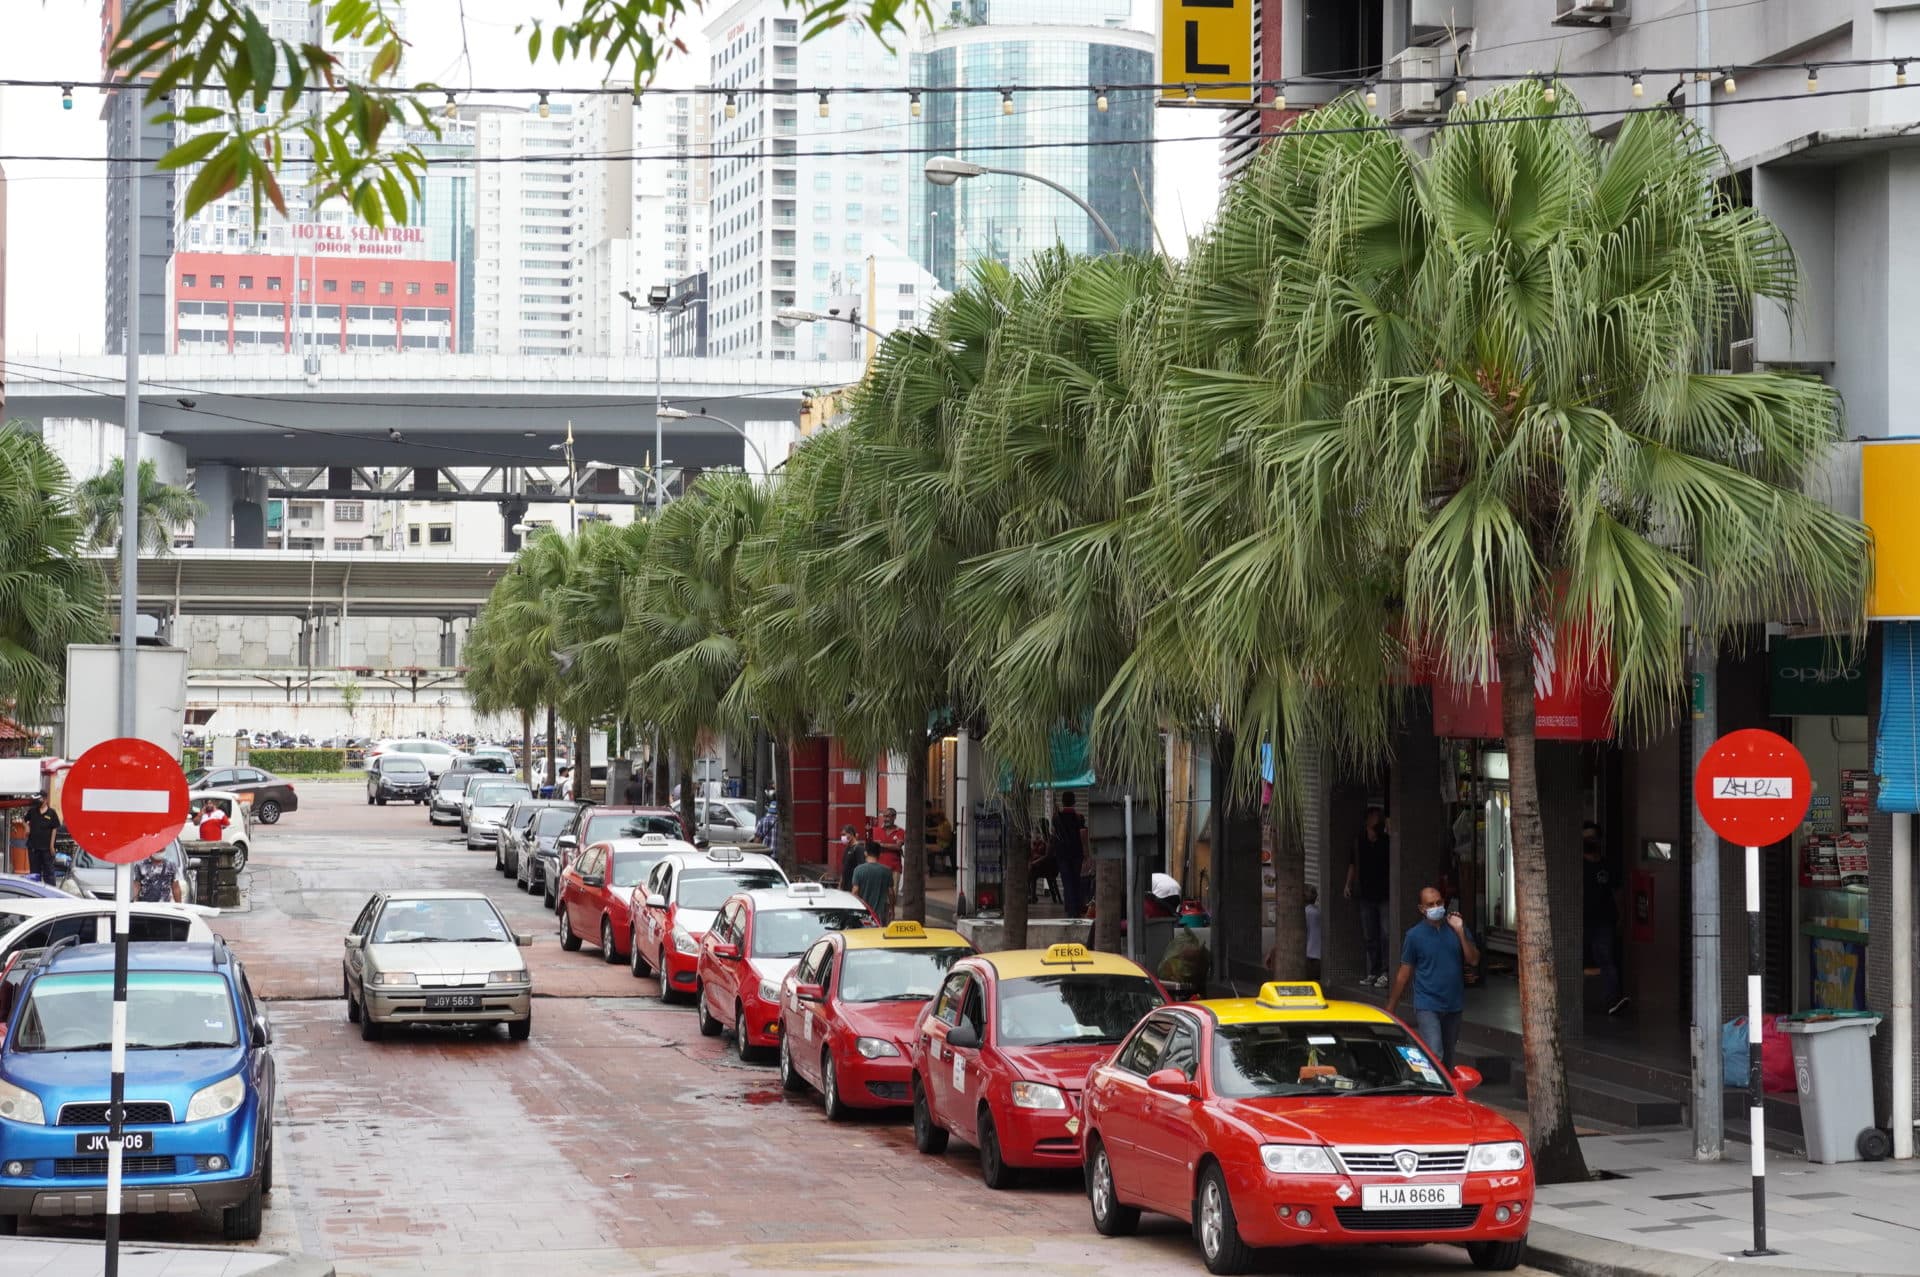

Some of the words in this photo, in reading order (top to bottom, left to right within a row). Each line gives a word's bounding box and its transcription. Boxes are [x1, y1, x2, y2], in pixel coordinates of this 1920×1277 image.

[291, 223, 345, 240] HOTEL
[351, 226, 425, 242] SENTRAL
[314, 242, 352, 253] JOHOR
[359, 244, 402, 254] BAHRU
[895, 925, 917, 934] TEKSI
[1054, 947, 1084, 957] TEKSI
[1379, 1189, 1407, 1204] HJA
[1409, 1188, 1446, 1203] 8686
